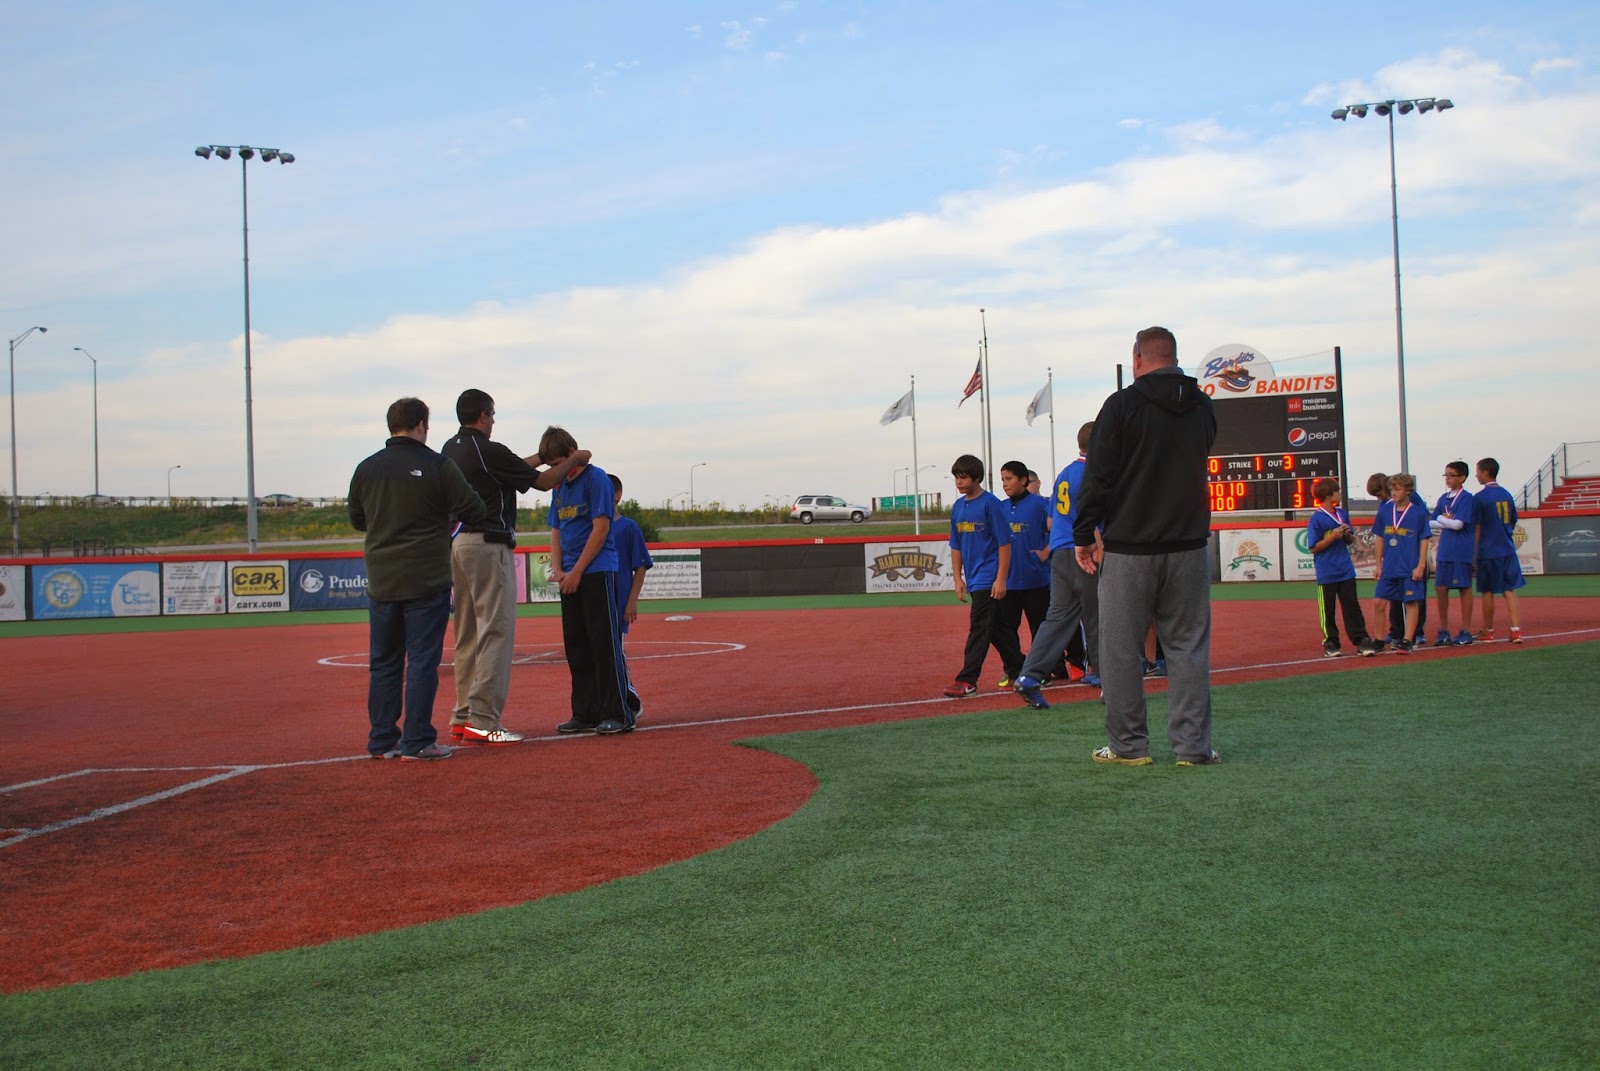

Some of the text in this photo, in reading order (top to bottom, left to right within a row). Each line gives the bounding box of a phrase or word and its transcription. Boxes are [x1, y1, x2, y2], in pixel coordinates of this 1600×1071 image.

[1256, 375, 1336, 394] BANDITS
[1303, 403, 1336, 411] business
[1308, 430, 1337, 442] pepsi
[1228, 461, 1252, 469] STRIKE
[1283, 455, 1292, 470] 3
[1056, 480, 1070, 515] 9
[1293, 493, 1302, 508] 3
[1495, 501, 1509, 524] 11
[878, 553, 934, 570] HARRY CARAY'S
[236, 601, 282, 609] carx.com
